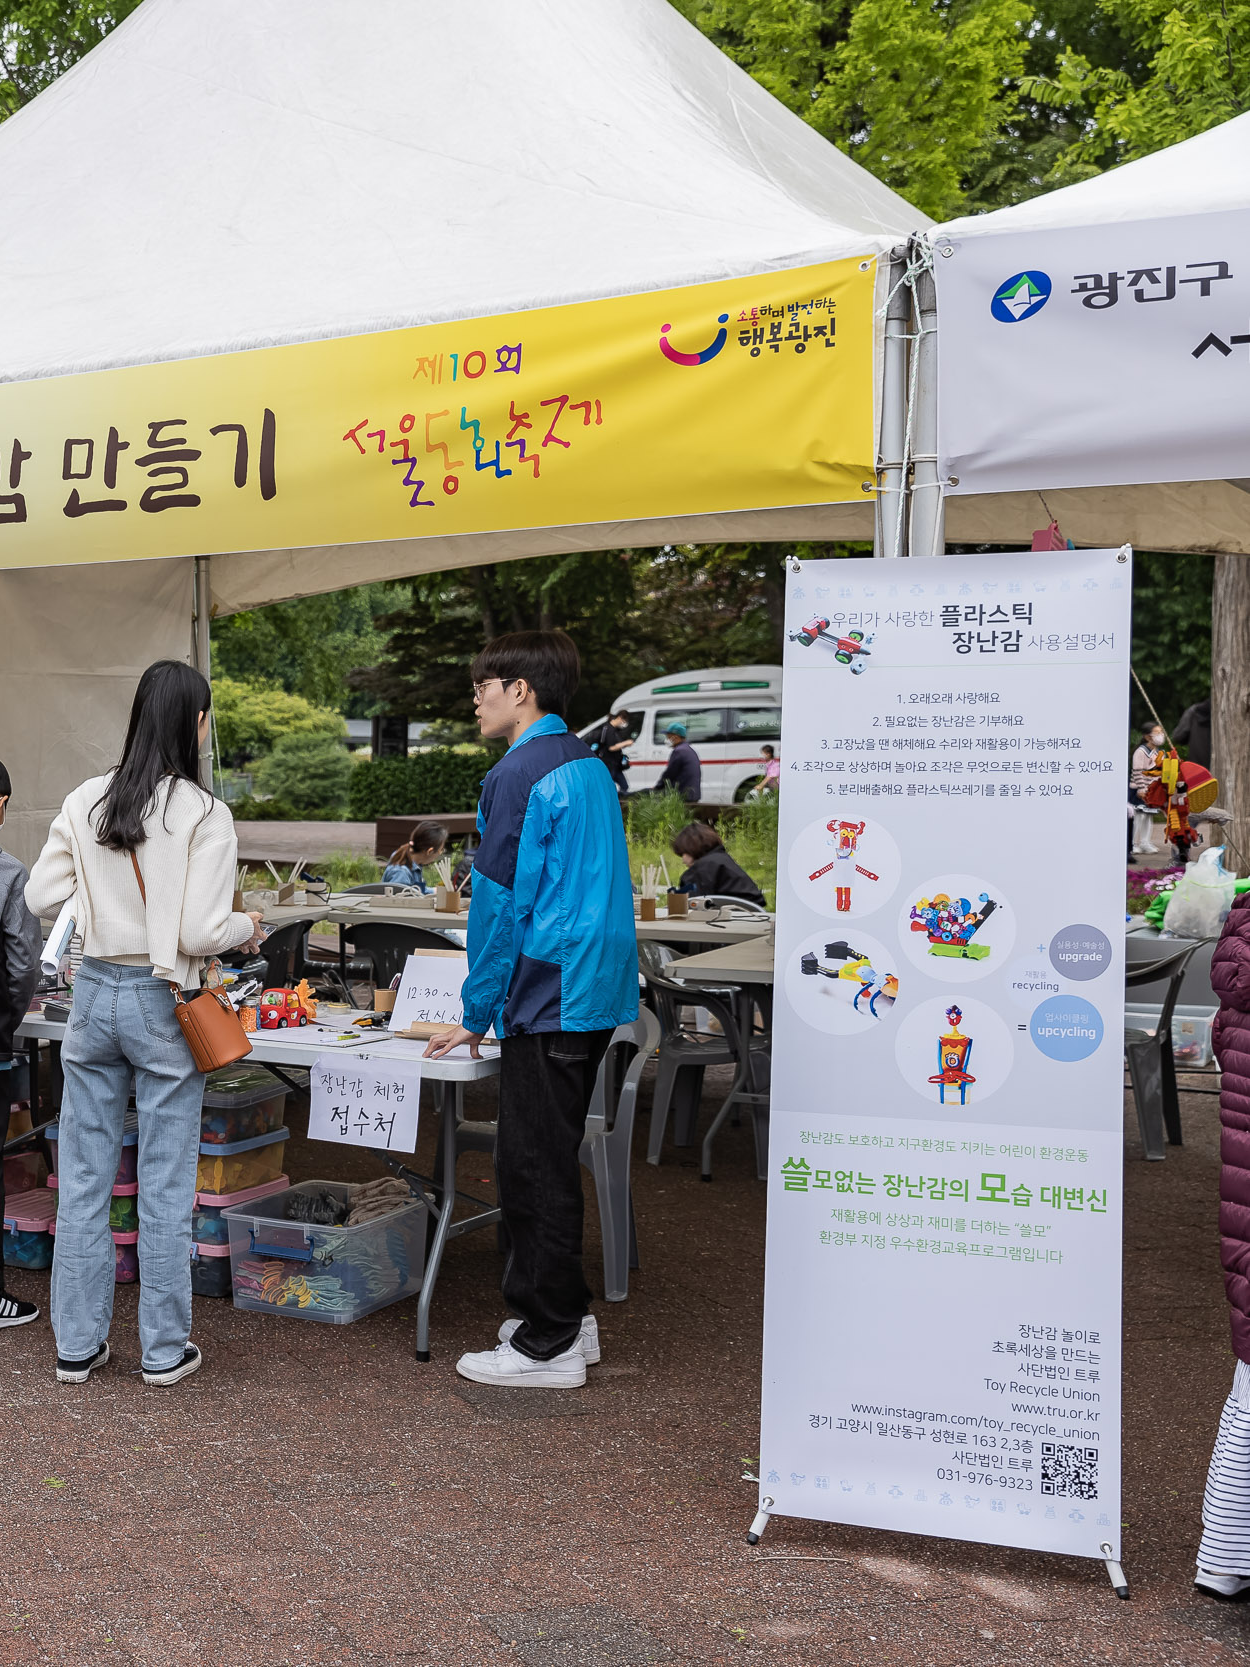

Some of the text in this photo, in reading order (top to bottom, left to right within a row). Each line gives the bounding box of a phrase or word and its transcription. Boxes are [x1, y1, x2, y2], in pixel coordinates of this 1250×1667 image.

[1070, 261, 1234, 310] 광진구
[737, 297, 837, 327] 소통하며 발전하는
[737, 317, 836, 357] 행복광진
[412, 342, 523, 385] 제10회
[62, 407, 277, 519] 만들기
[830, 601, 1034, 629] 우리가 사랑한 플라스틱
[951, 630, 1115, 654] 장난감 사용설명서
[896, 692, 1001, 705] 1. 오래오래 사랑해요
[872, 714, 1025, 728] 2. 필요없는 장난감은 기부해요
[820, 737, 1082, 751] 3. 고장났을 땐 해체해요 수리와 재활용이 가능해져요
[790, 760, 1114, 773] 4. 조각으로 상상하며 놀아요 조각은 무엇으로든 변신할 수 있어요
[826, 783, 1074, 797] 5. 분리배출해요 플라스틱쓰레기를 줄일 수 있어요
[1058, 952, 1103, 963] upgrade
[407, 986, 439, 999] 12:30
[1012, 982, 1059, 992] recycling
[416, 1009, 463, 1024] 점심시
[1037, 1026, 1096, 1040] upcycling
[320, 1072, 405, 1102] 장난감 체험
[330, 1105, 396, 1148] 접수처
[799, 1131, 1089, 1163] 장난감도 보호하고 지구환경도 지키는 어린이 환경운동
[781, 1156, 1108, 1213] 쓸모없는 장난감의 모습 대변신
[830, 1208, 882, 1226] 재활용에
[885, 1212, 924, 1228] 상상과
[927, 1216, 967, 1233] 재미를
[971, 1219, 1011, 1236] 더하는
[819, 1230, 1064, 1265] 환경부 지정 우수환경교육프로그램입니다
[1018, 1323, 1101, 1344] 장난감 놀이로
[991, 1341, 1101, 1365] 초록세상을 만드는
[1017, 1362, 1100, 1384] 사단법인 트루
[984, 1378, 1100, 1402] Toy Recycle Union
[851, 1402, 1100, 1441] www.instagram.com/toy_recycle_union
[1011, 1402, 1100, 1421] www.tru.or.kr
[808, 1414, 1034, 1454] 경기 고양시 일산동구 성현로 163 2,3층
[952, 1450, 1033, 1472] 사단법인 트루
[936, 1467, 1034, 1492] 031-976-9323
